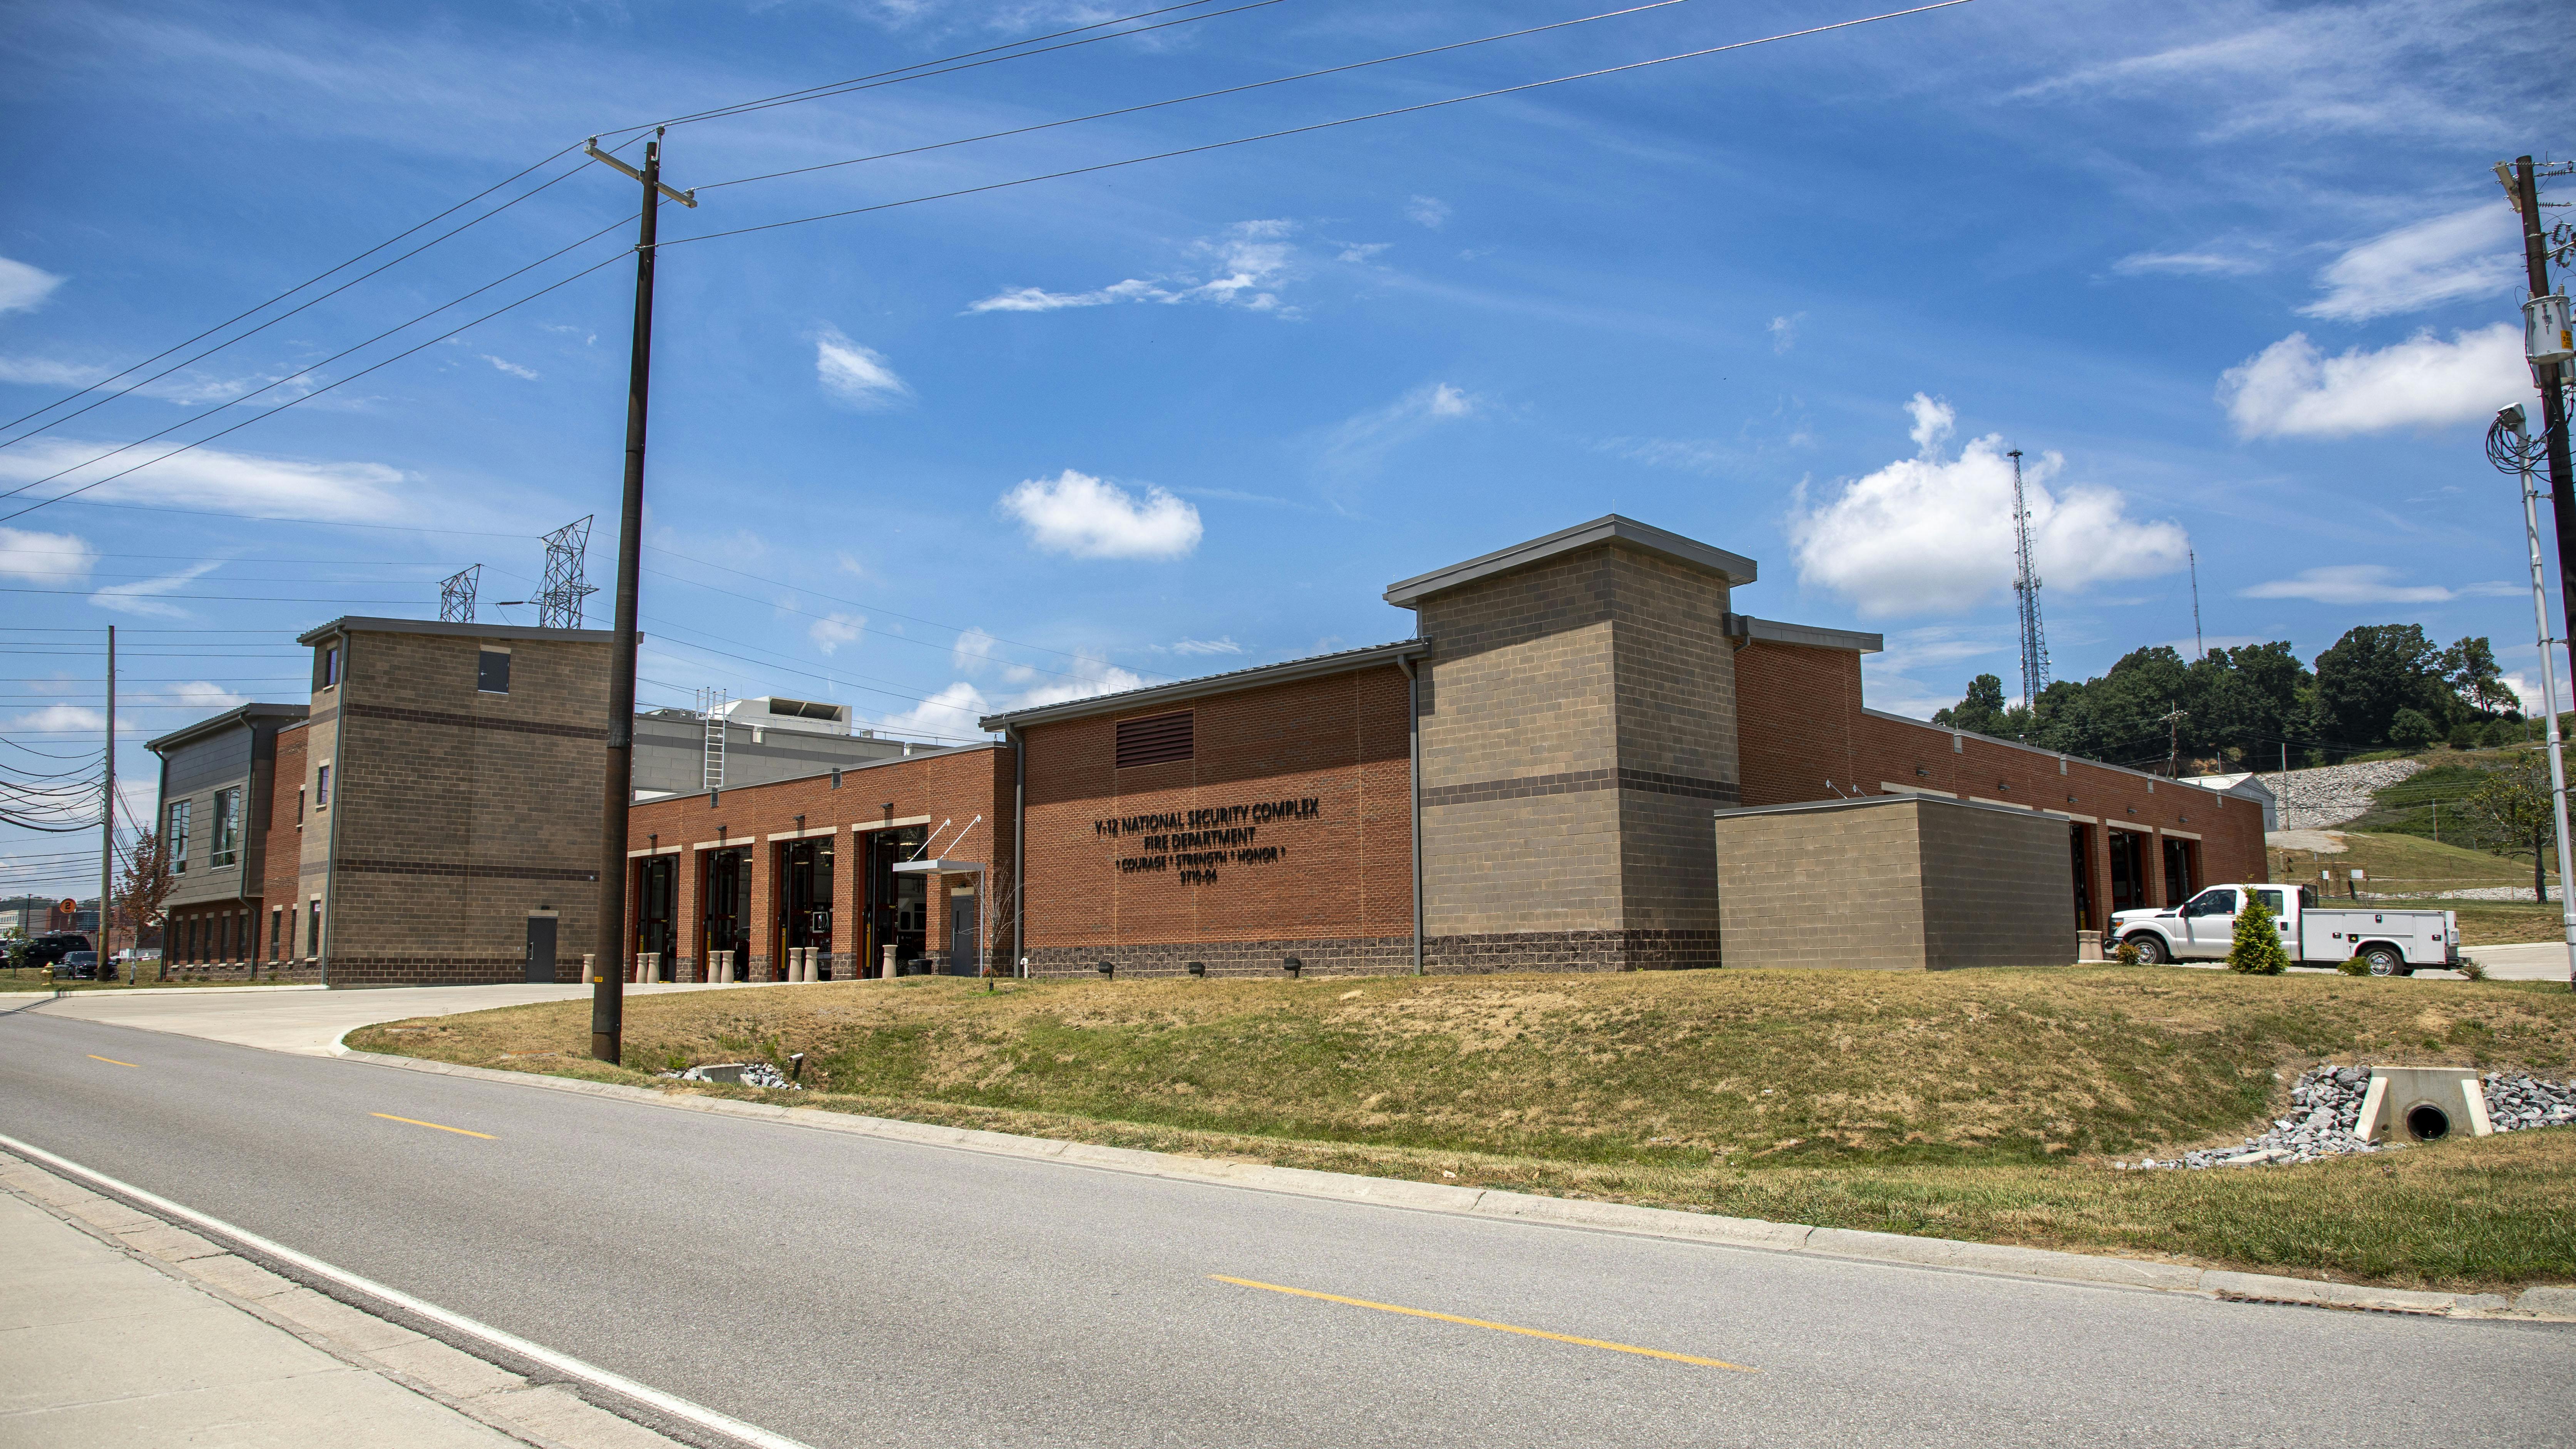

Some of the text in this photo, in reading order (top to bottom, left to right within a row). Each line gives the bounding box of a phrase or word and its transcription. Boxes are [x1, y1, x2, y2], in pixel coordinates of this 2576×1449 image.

[1095, 797, 1319, 835] Y-12 NATIONAL SECURITY COMPLEX
[1144, 827, 1256, 850] FIRE DEPARTMENT
[1122, 847, 1278, 868] COURAGE STRENGTH HONOR
[1180, 868, 1218, 882] 9710-04
